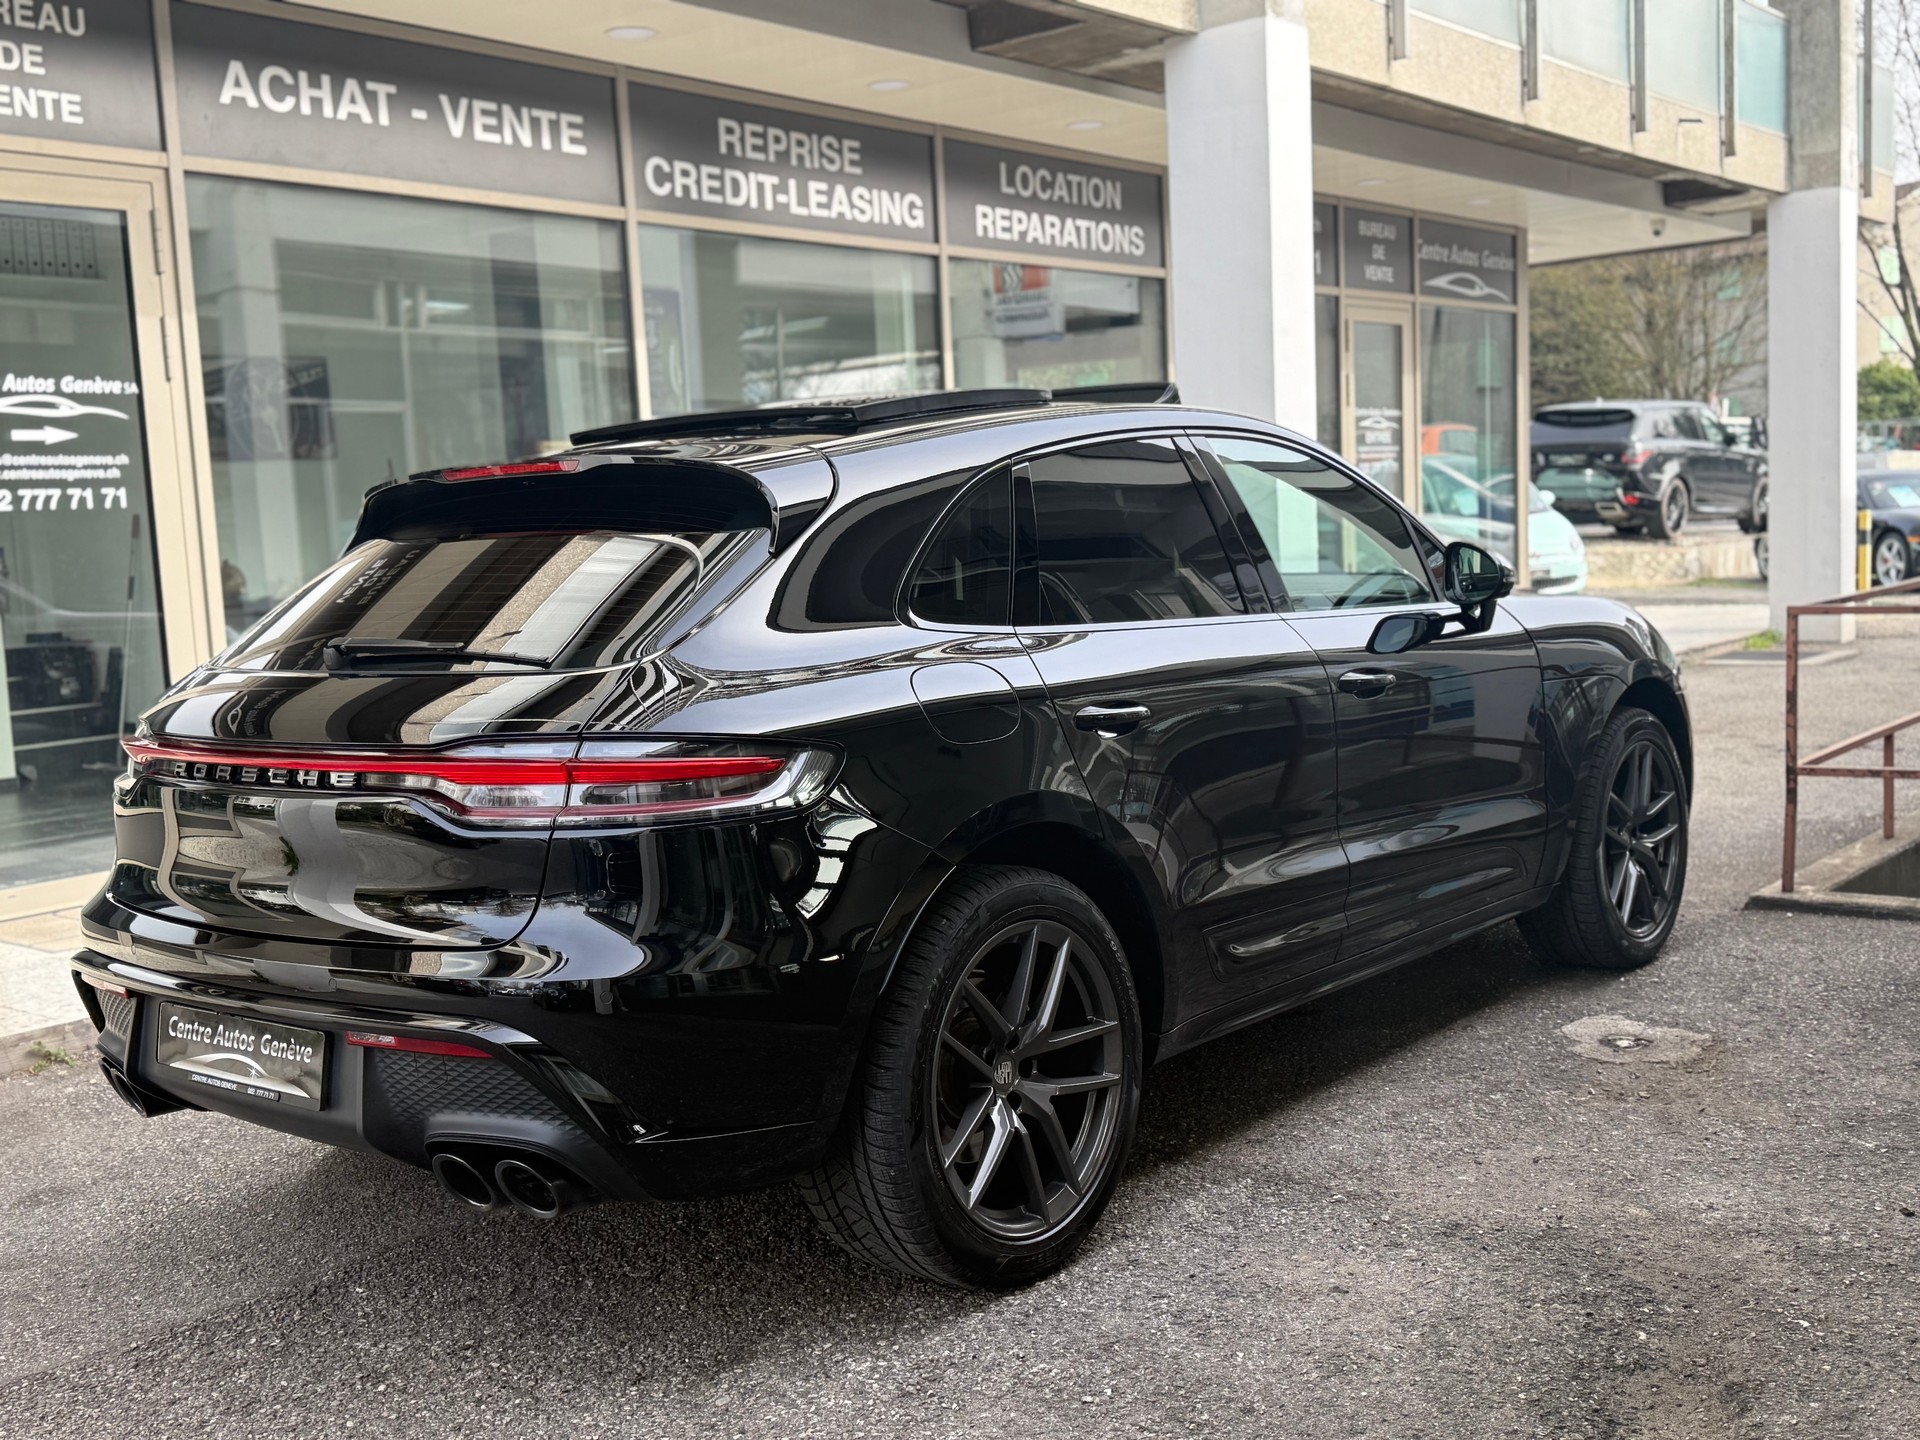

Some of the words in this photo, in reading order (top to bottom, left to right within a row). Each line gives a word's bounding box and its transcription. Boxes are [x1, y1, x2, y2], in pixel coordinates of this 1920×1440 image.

[0, 39, 46, 76] DE
[219, 59, 397, 127] ACHAT
[411, 108, 428, 121] -
[438, 93, 588, 156] VENTE
[717, 116, 863, 175] REPRISE
[644, 155, 925, 229] CREDIT-LEASING
[1000, 161, 1122, 211] LOCATION
[975, 203, 1145, 256] REPARATIONS
[1358, 219, 1397, 241] BUREAU
[1372, 243, 1386, 261] DE
[1363, 264, 1394, 283] VENTE
[2, 373, 56, 393] Autos
[60, 375, 123, 394] Genève
[17, 488, 62, 512] 777
[66, 487, 94, 511] 71
[100, 486, 128, 510] 71
[174, 761, 357, 788] PORSCHE
[168, 1015, 212, 1044] Centre
[213, 1024, 255, 1053] Autos
[260, 1034, 313, 1064] Genève
